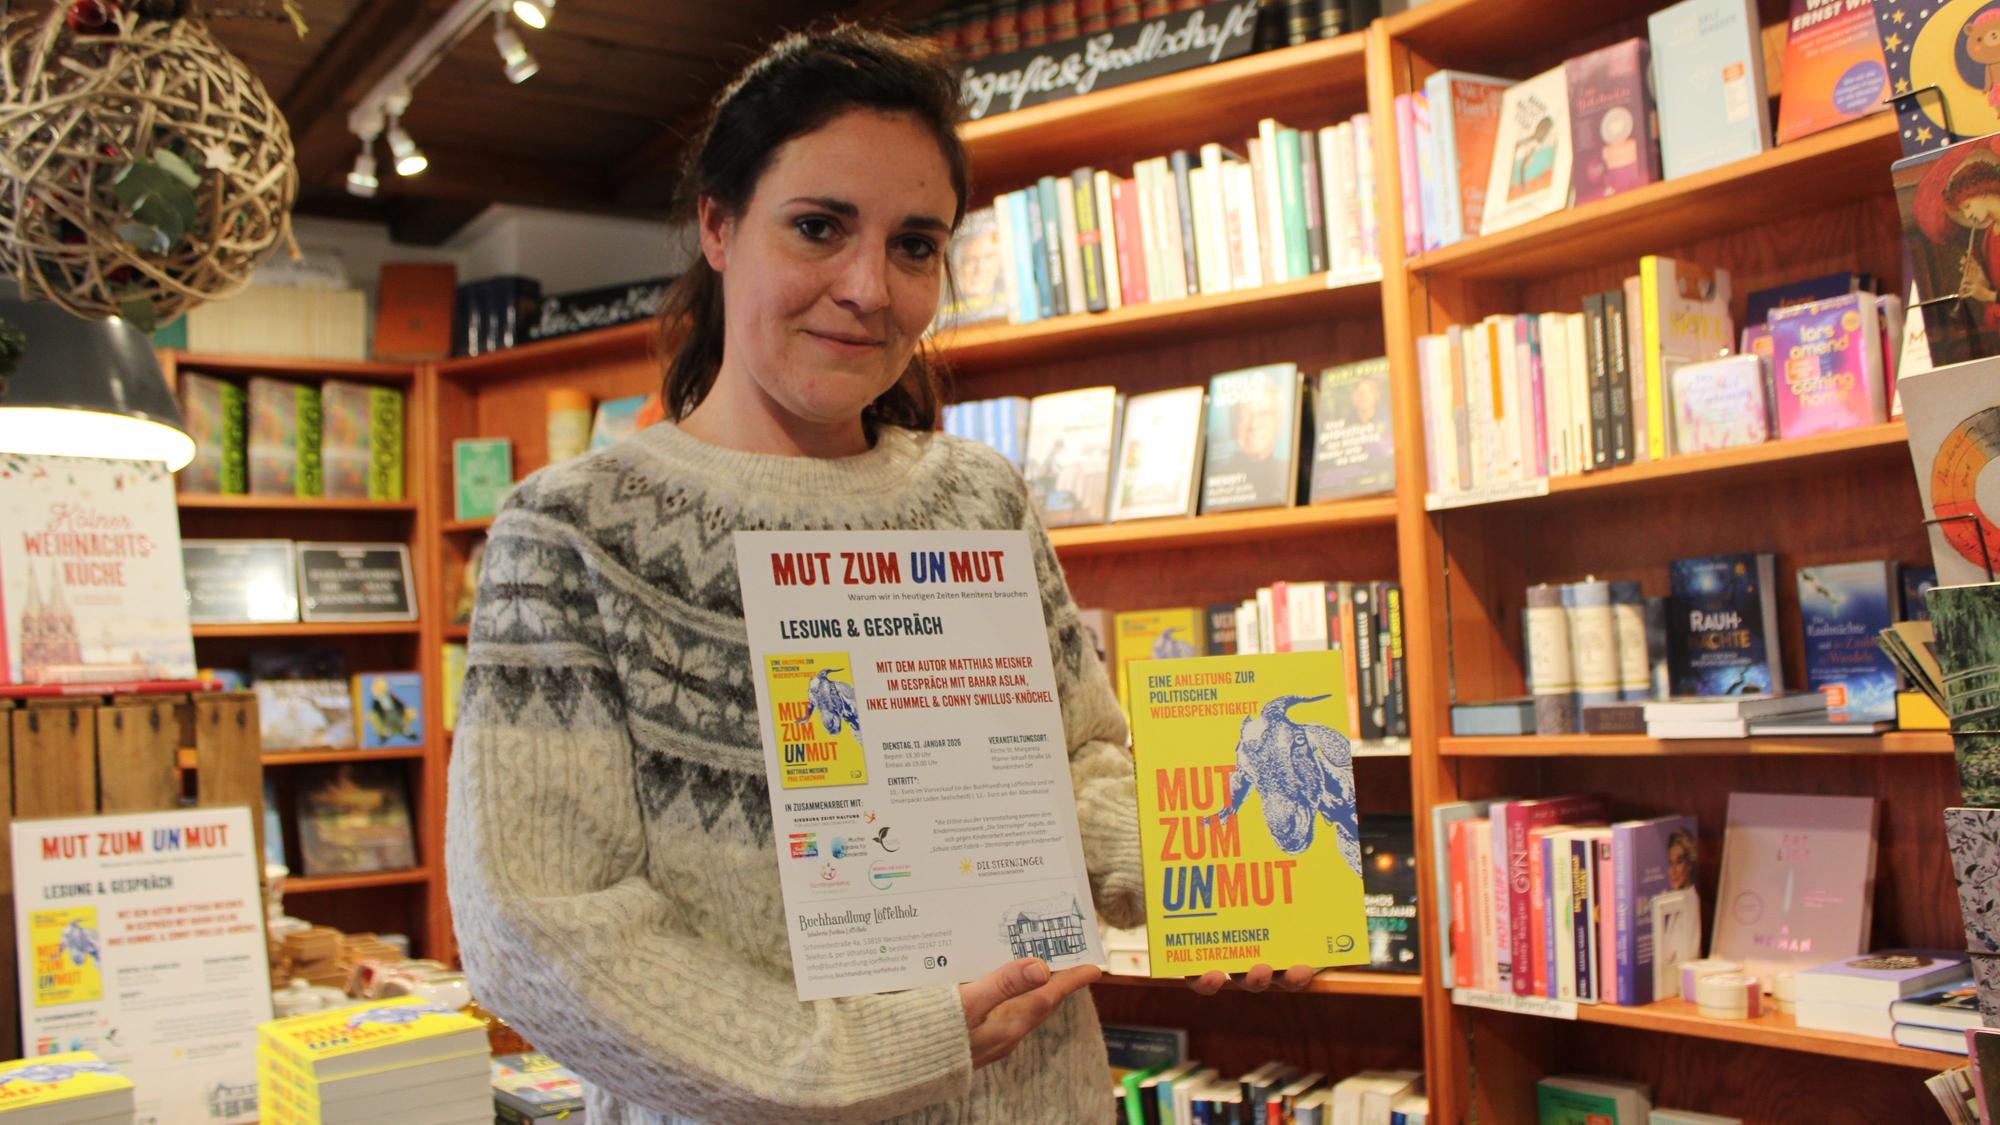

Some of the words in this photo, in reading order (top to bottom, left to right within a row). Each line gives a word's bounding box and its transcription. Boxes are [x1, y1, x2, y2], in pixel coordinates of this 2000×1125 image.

[1792, 2, 1841, 32] ERNST
[771, 553, 831, 586] MUT
[840, 552, 901, 585] ZUM
[848, 593, 876, 601] Warum
[902, 592, 935, 602] heutigen
[937, 591, 960, 600] Zeiten
[962, 590, 992, 600] Renitenz
[994, 590, 1028, 599] brauchen
[780, 619, 841, 639] LESUNG
[847, 618, 860, 637] &
[864, 613, 943, 637] GESPRÄCH
[876, 661, 893, 672] MIT
[896, 661, 915, 672] DEM
[919, 659, 947, 671] AUTOR
[949, 658, 993, 671] MATTHIAS
[995, 656, 1033, 668] MEISNER
[887, 679, 899, 690] IM
[901, 675, 948, 690] GESPRÄCH
[950, 677, 965, 688] MIT
[969, 675, 996, 688] BAHAR
[999, 674, 1029, 687] ASLAN,
[1148, 675, 1172, 688] EINE
[1174, 672, 1232, 687] ANLEITUNG
[1234, 671, 1255, 684] ZUR
[866, 699, 888, 710] INKE
[890, 696, 930, 709] HUMMEL
[932, 696, 940, 707] &
[942, 694, 971, 706] CONNY
[973, 690, 1053, 705] SWILLUS-KNÖCHEL
[1149, 688, 1217, 704] POLITISCHEN
[778, 701, 811, 721] MUT
[1150, 701, 1258, 719] WIDERSPENSTIGKEIT
[781, 722, 815, 742] ZUM
[784, 742, 838, 763] UNMUT
[882, 741, 913, 750] DIENSTAG,
[923, 739, 945, 748] JANUAR
[947, 738, 961, 747] 2026
[1156, 765, 1237, 812] MUT
[785, 804, 792, 812] IN
[793, 800, 849, 811] ZUSAMMENARBEIT
[850, 799, 864, 808] MIT:
[42, 834, 89, 860] MUT
[97, 831, 144, 857] ZUM
[1160, 813, 1242, 862] ZUM
[977, 861, 990, 870] DIE
[992, 856, 1044, 869] STERNSINGER
[43, 882, 92, 900] LESUNG
[111, 874, 173, 895] GESPRÄCH
[1162, 860, 1297, 912] UNMUT
[800, 910, 871, 931] Buchhandlung
[873, 905, 918, 924] Löffelholz
[1165, 931, 1220, 947] MATTHIAS
[1221, 928, 1270, 945] MEISNER
[1166, 948, 1194, 963] PAUL
[1195, 946, 1261, 962] STARZMANN
